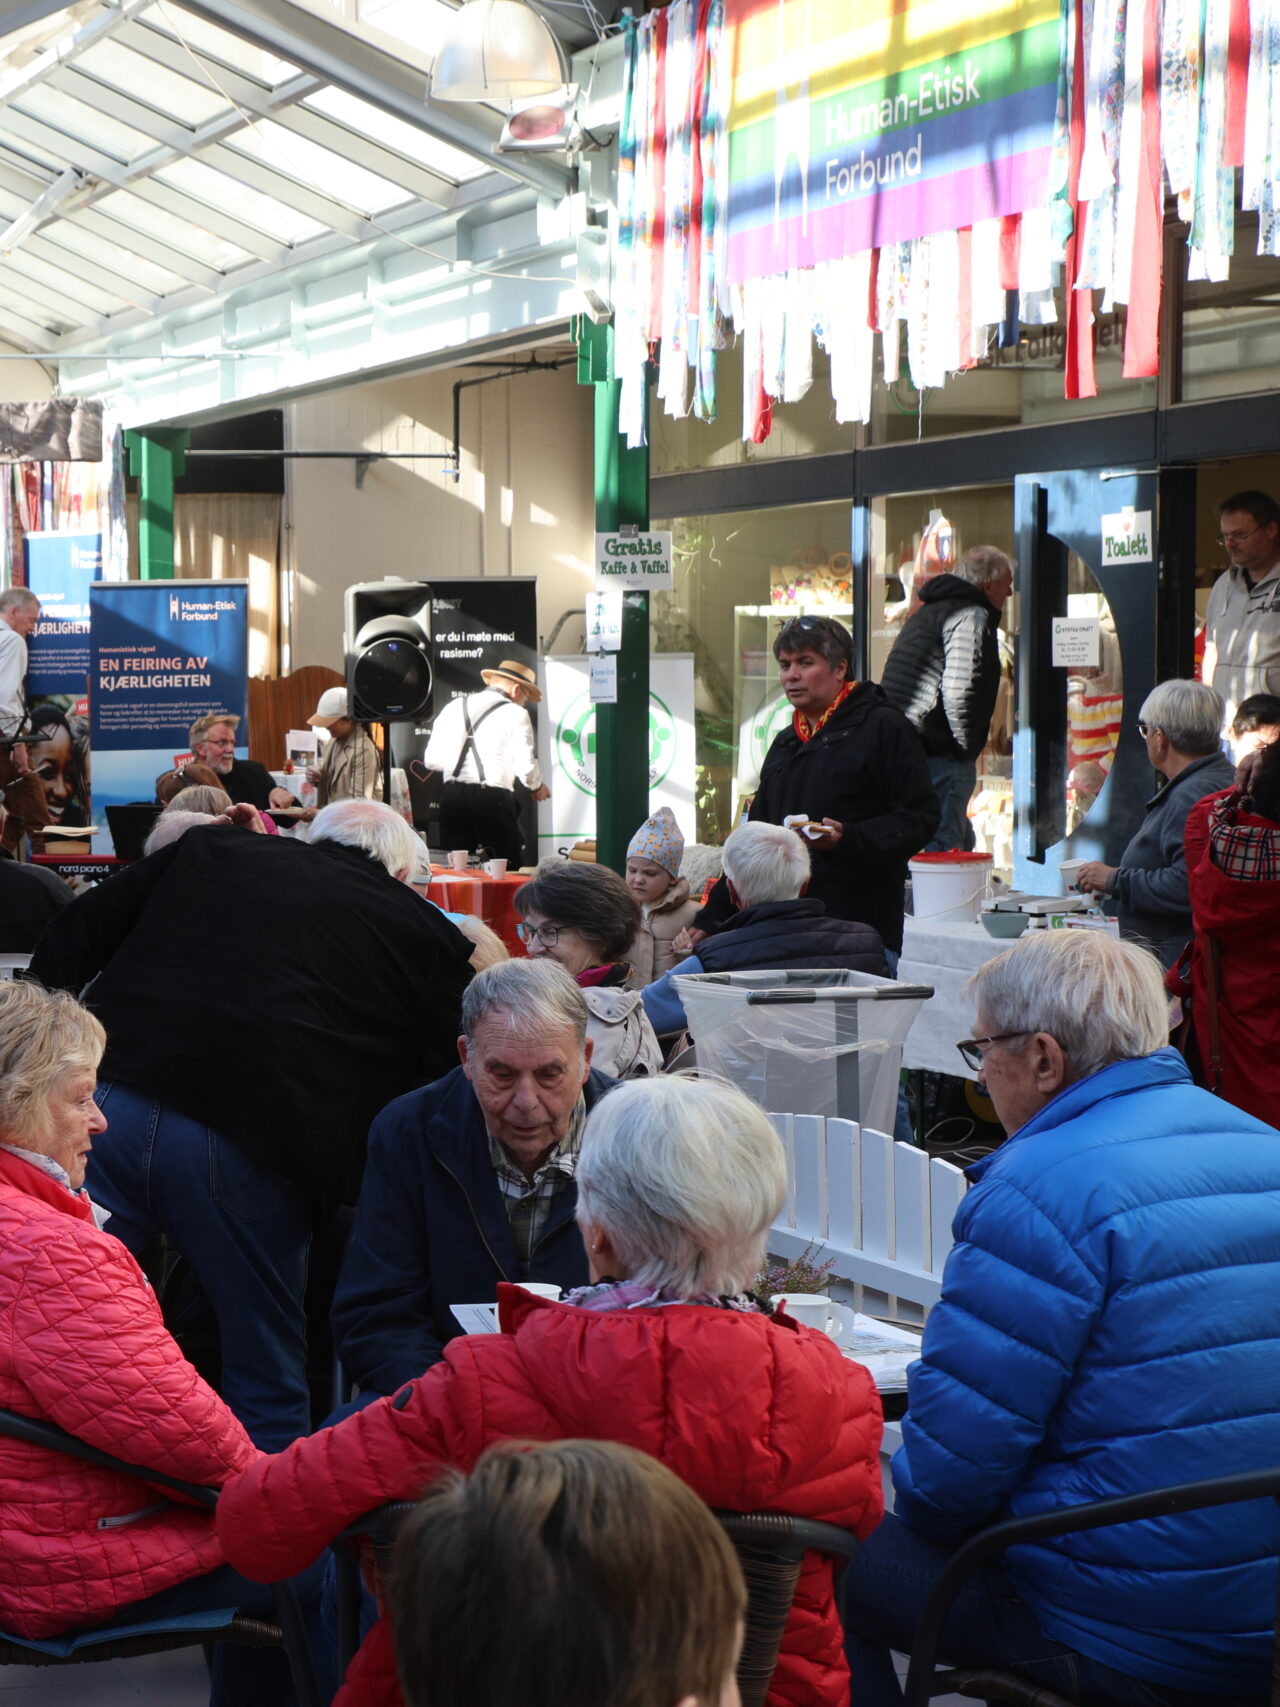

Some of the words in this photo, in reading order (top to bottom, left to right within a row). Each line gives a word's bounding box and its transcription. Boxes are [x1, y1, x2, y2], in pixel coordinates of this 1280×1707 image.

[824, 59, 981, 147] Human-Etisk
[825, 134, 922, 200] Forbund
[604, 538, 663, 557] Gratis
[1105, 533, 1148, 558] Toalett
[600, 561, 627, 575] Kaffe
[631, 562, 638, 574] &
[640, 560, 669, 574] Vaffel
[182, 601, 236, 610] Human-Etisk
[182, 612, 218, 621] Forbund
[435, 633, 446, 642] er
[447, 632, 460, 642] du
[466, 631, 491, 642] møte
[493, 631, 515, 642] med
[138, 646, 156, 654] vigsel
[440, 647, 483, 658] rasisme?
[100, 658, 119, 671] EN
[123, 657, 182, 671] FEIRING
[186, 656, 208, 670] AV
[100, 674, 211, 691] KJÆRLIGHETEN
[58, 865, 79, 873] nord
[80, 865, 103, 873] piano
[104, 865, 109, 873] 4
